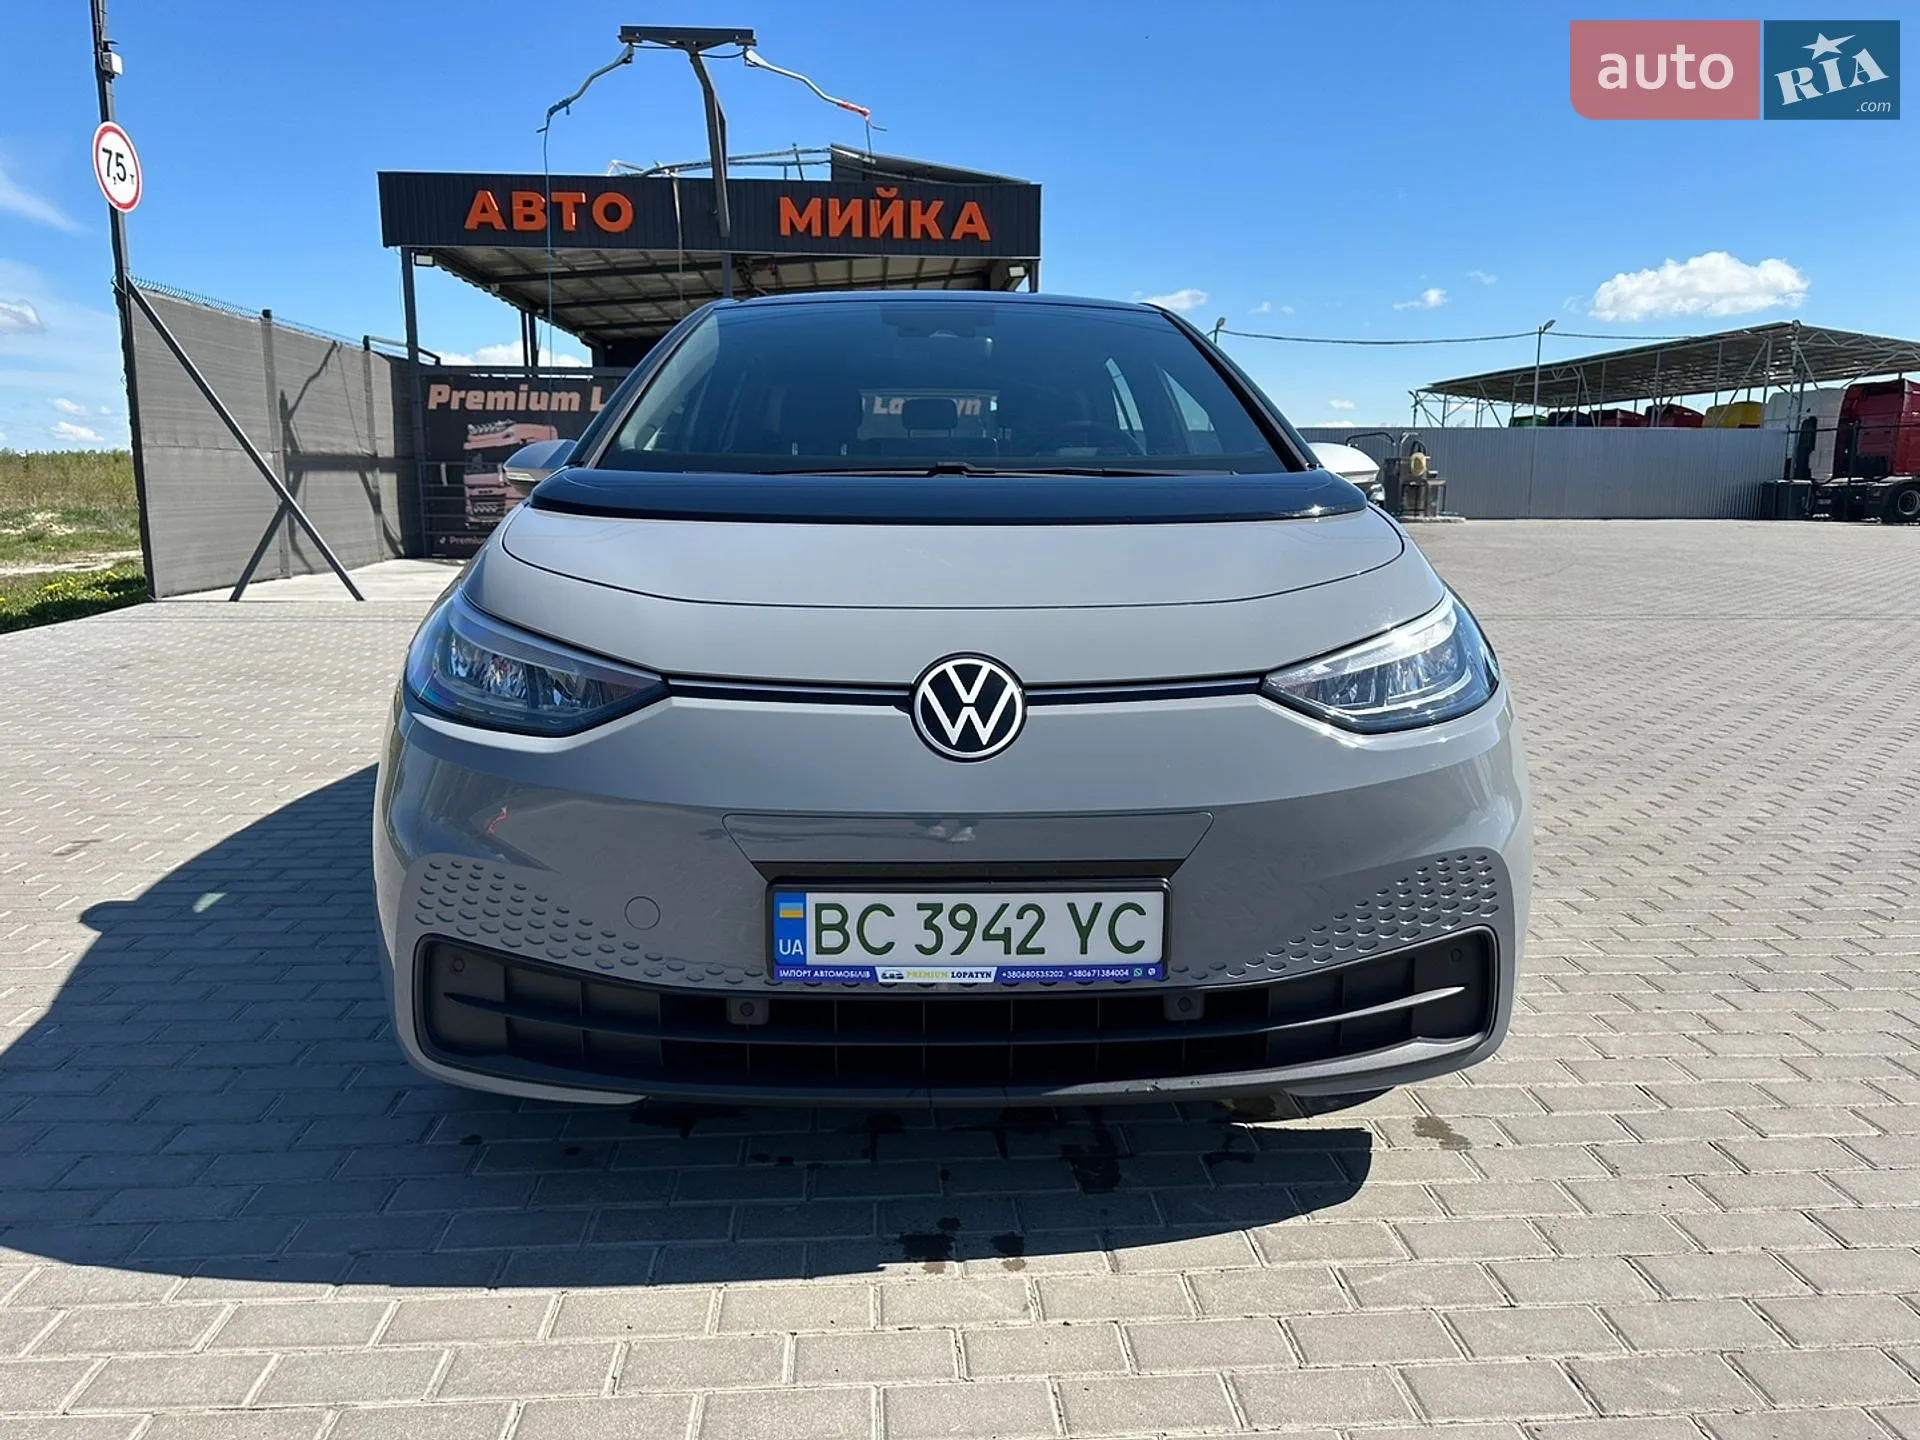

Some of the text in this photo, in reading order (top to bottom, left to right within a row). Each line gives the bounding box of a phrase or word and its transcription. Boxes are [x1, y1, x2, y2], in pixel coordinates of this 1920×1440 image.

[102, 147, 126, 185] 7,5
[464, 186, 991, 241] АВТО МИЙКА
[428, 384, 580, 411] Premium
[815, 902, 1147, 955] BC 3942 YC
[779, 939, 804, 956] UA
[907, 971, 992, 979] PREMIUM LOPATYN
